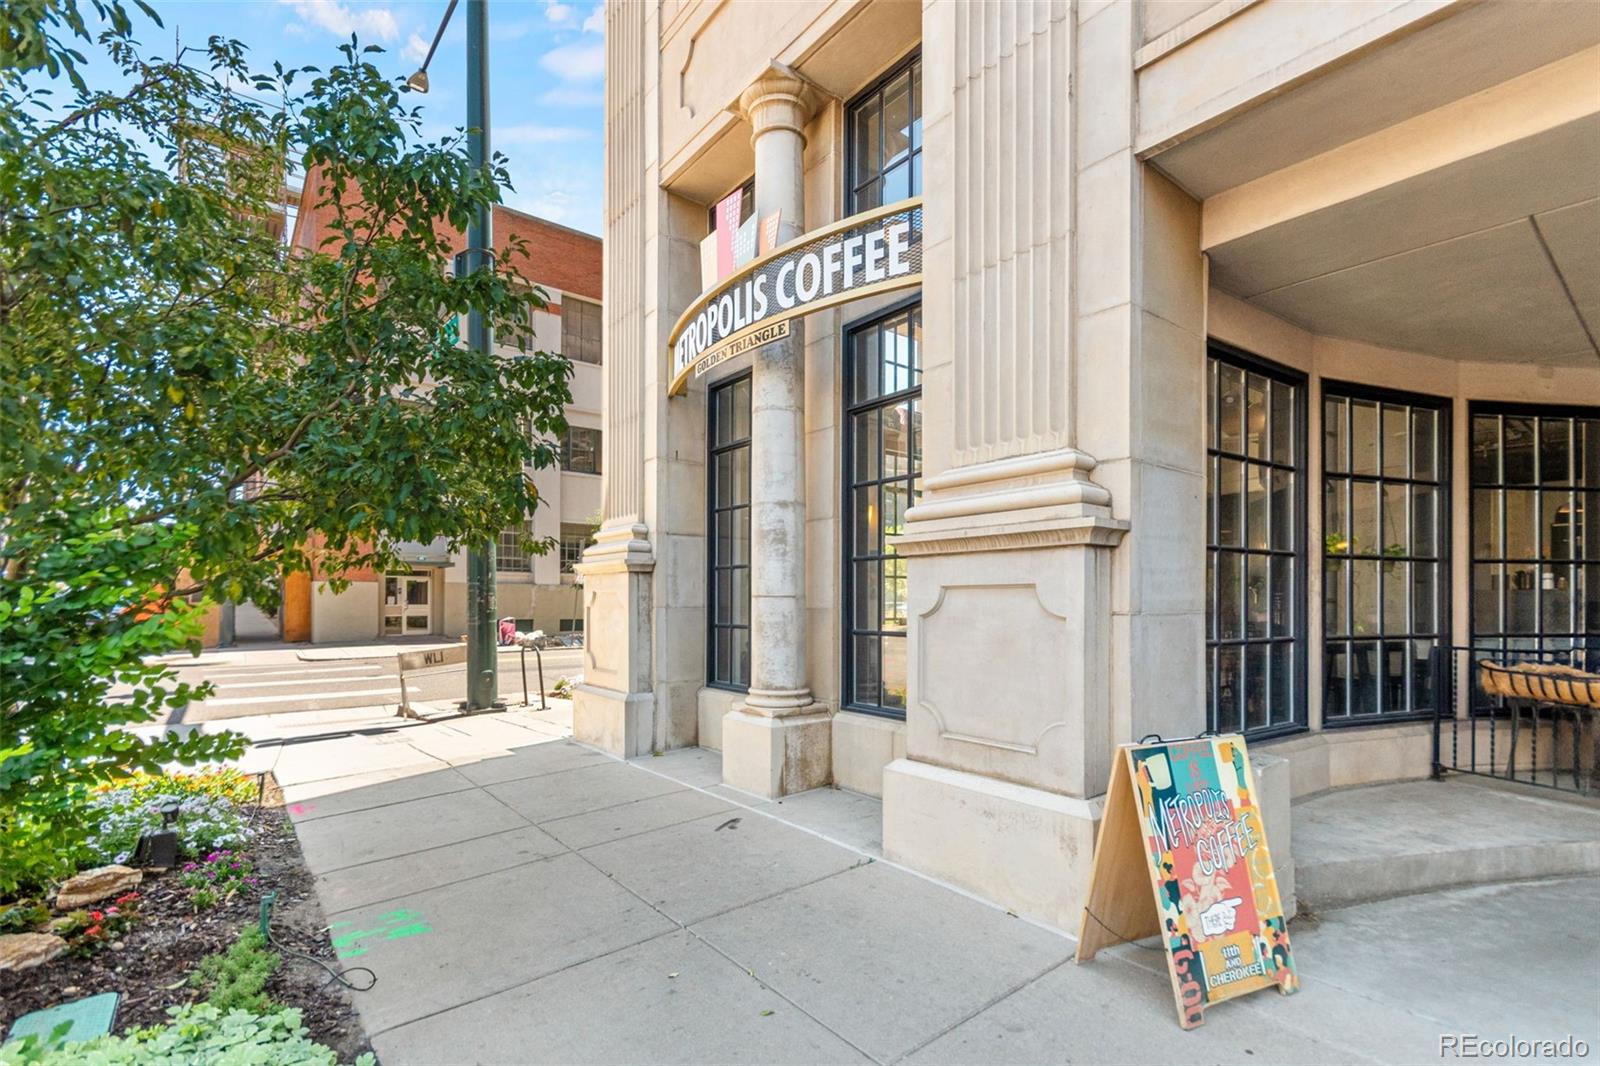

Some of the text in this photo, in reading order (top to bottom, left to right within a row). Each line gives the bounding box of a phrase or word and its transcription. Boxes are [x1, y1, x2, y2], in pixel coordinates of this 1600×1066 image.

[776, 222, 910, 309] COFFEE
[697, 323, 786, 374] GOLDEN TRIANGLE
[1149, 788, 1231, 865] METROPOLIS
[1196, 814, 1258, 876] COFFEE
[1209, 962, 1263, 987] CHEROKEE
[1226, 957, 1242, 970] AND
